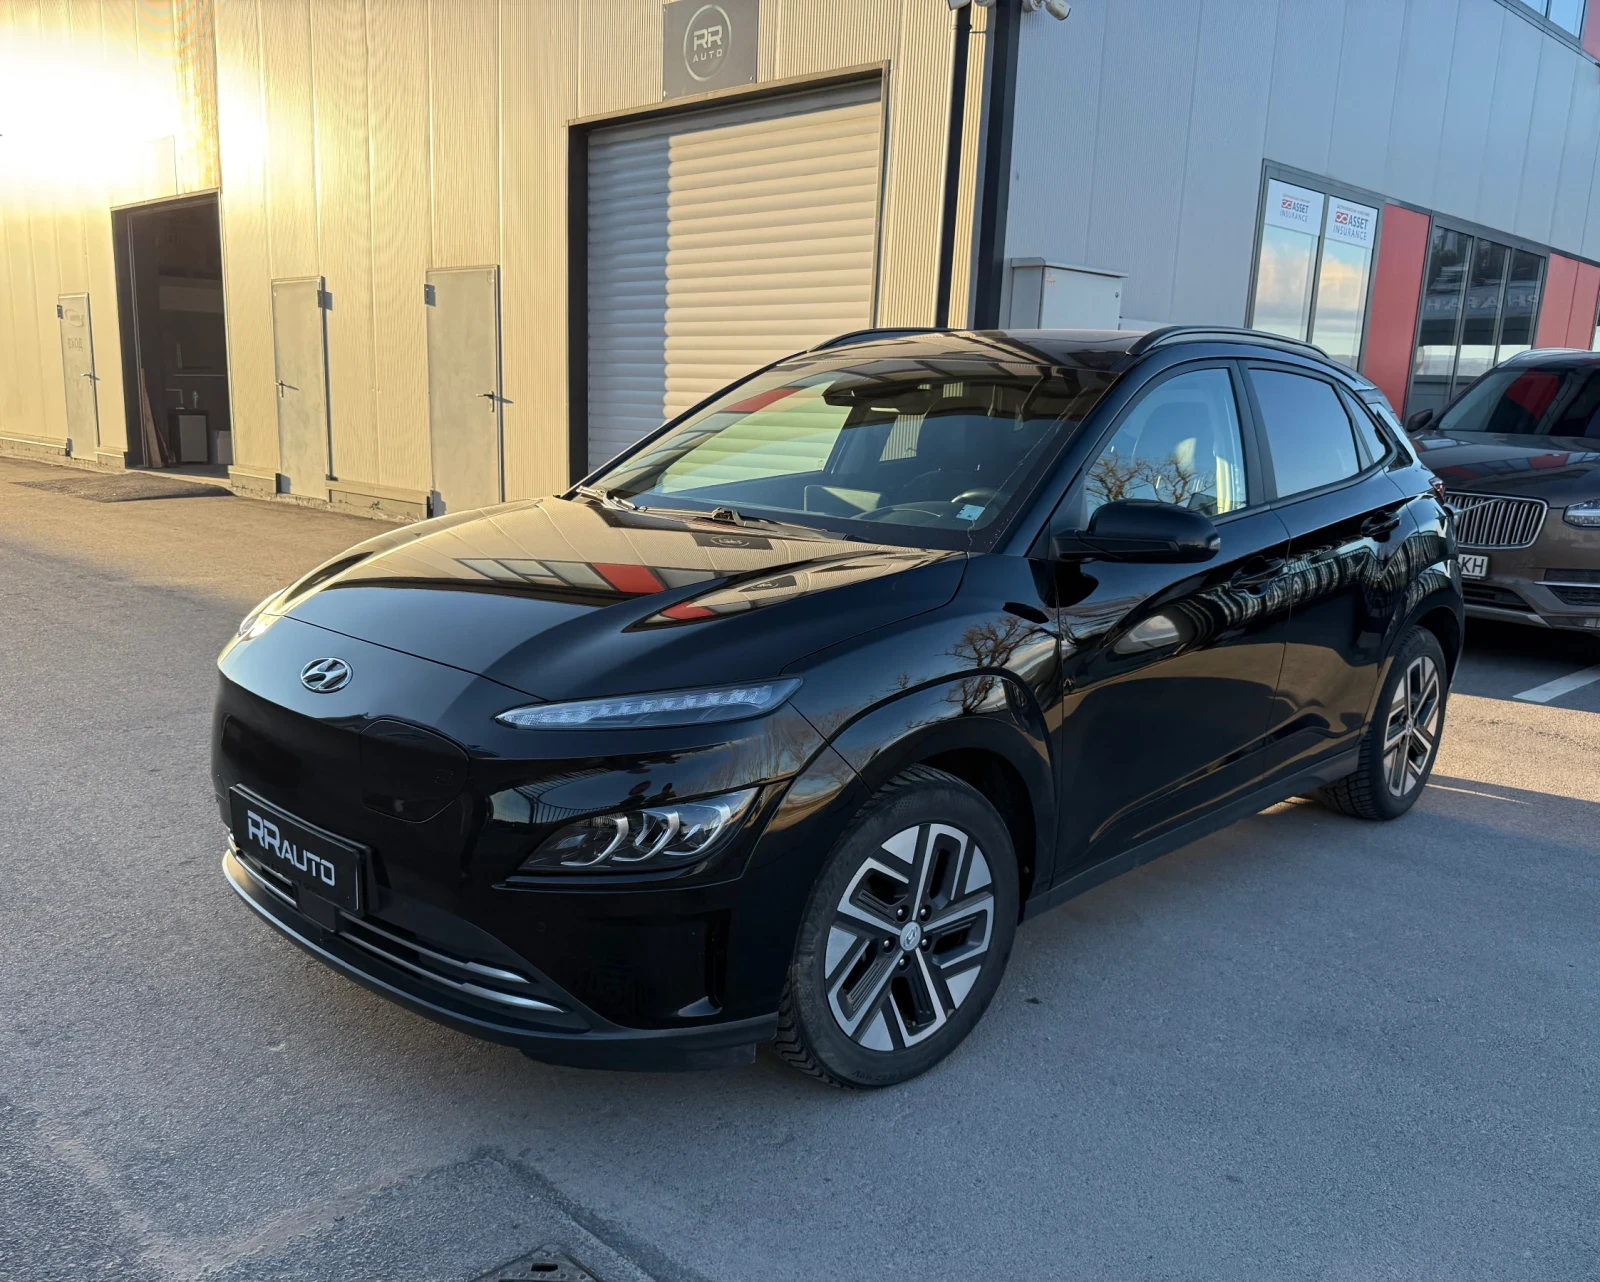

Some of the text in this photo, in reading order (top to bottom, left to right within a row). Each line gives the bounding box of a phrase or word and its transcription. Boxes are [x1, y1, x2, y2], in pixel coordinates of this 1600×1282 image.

[693, 25, 723, 51] RR
[692, 49, 723, 63] AUTO
[1292, 201, 1310, 214] ASSET
[1280, 210, 1308, 223] INSURANCE
[1348, 214, 1369, 231] ASSET
[1333, 224, 1367, 241] INSURANCE
[1461, 556, 1485, 574] KH
